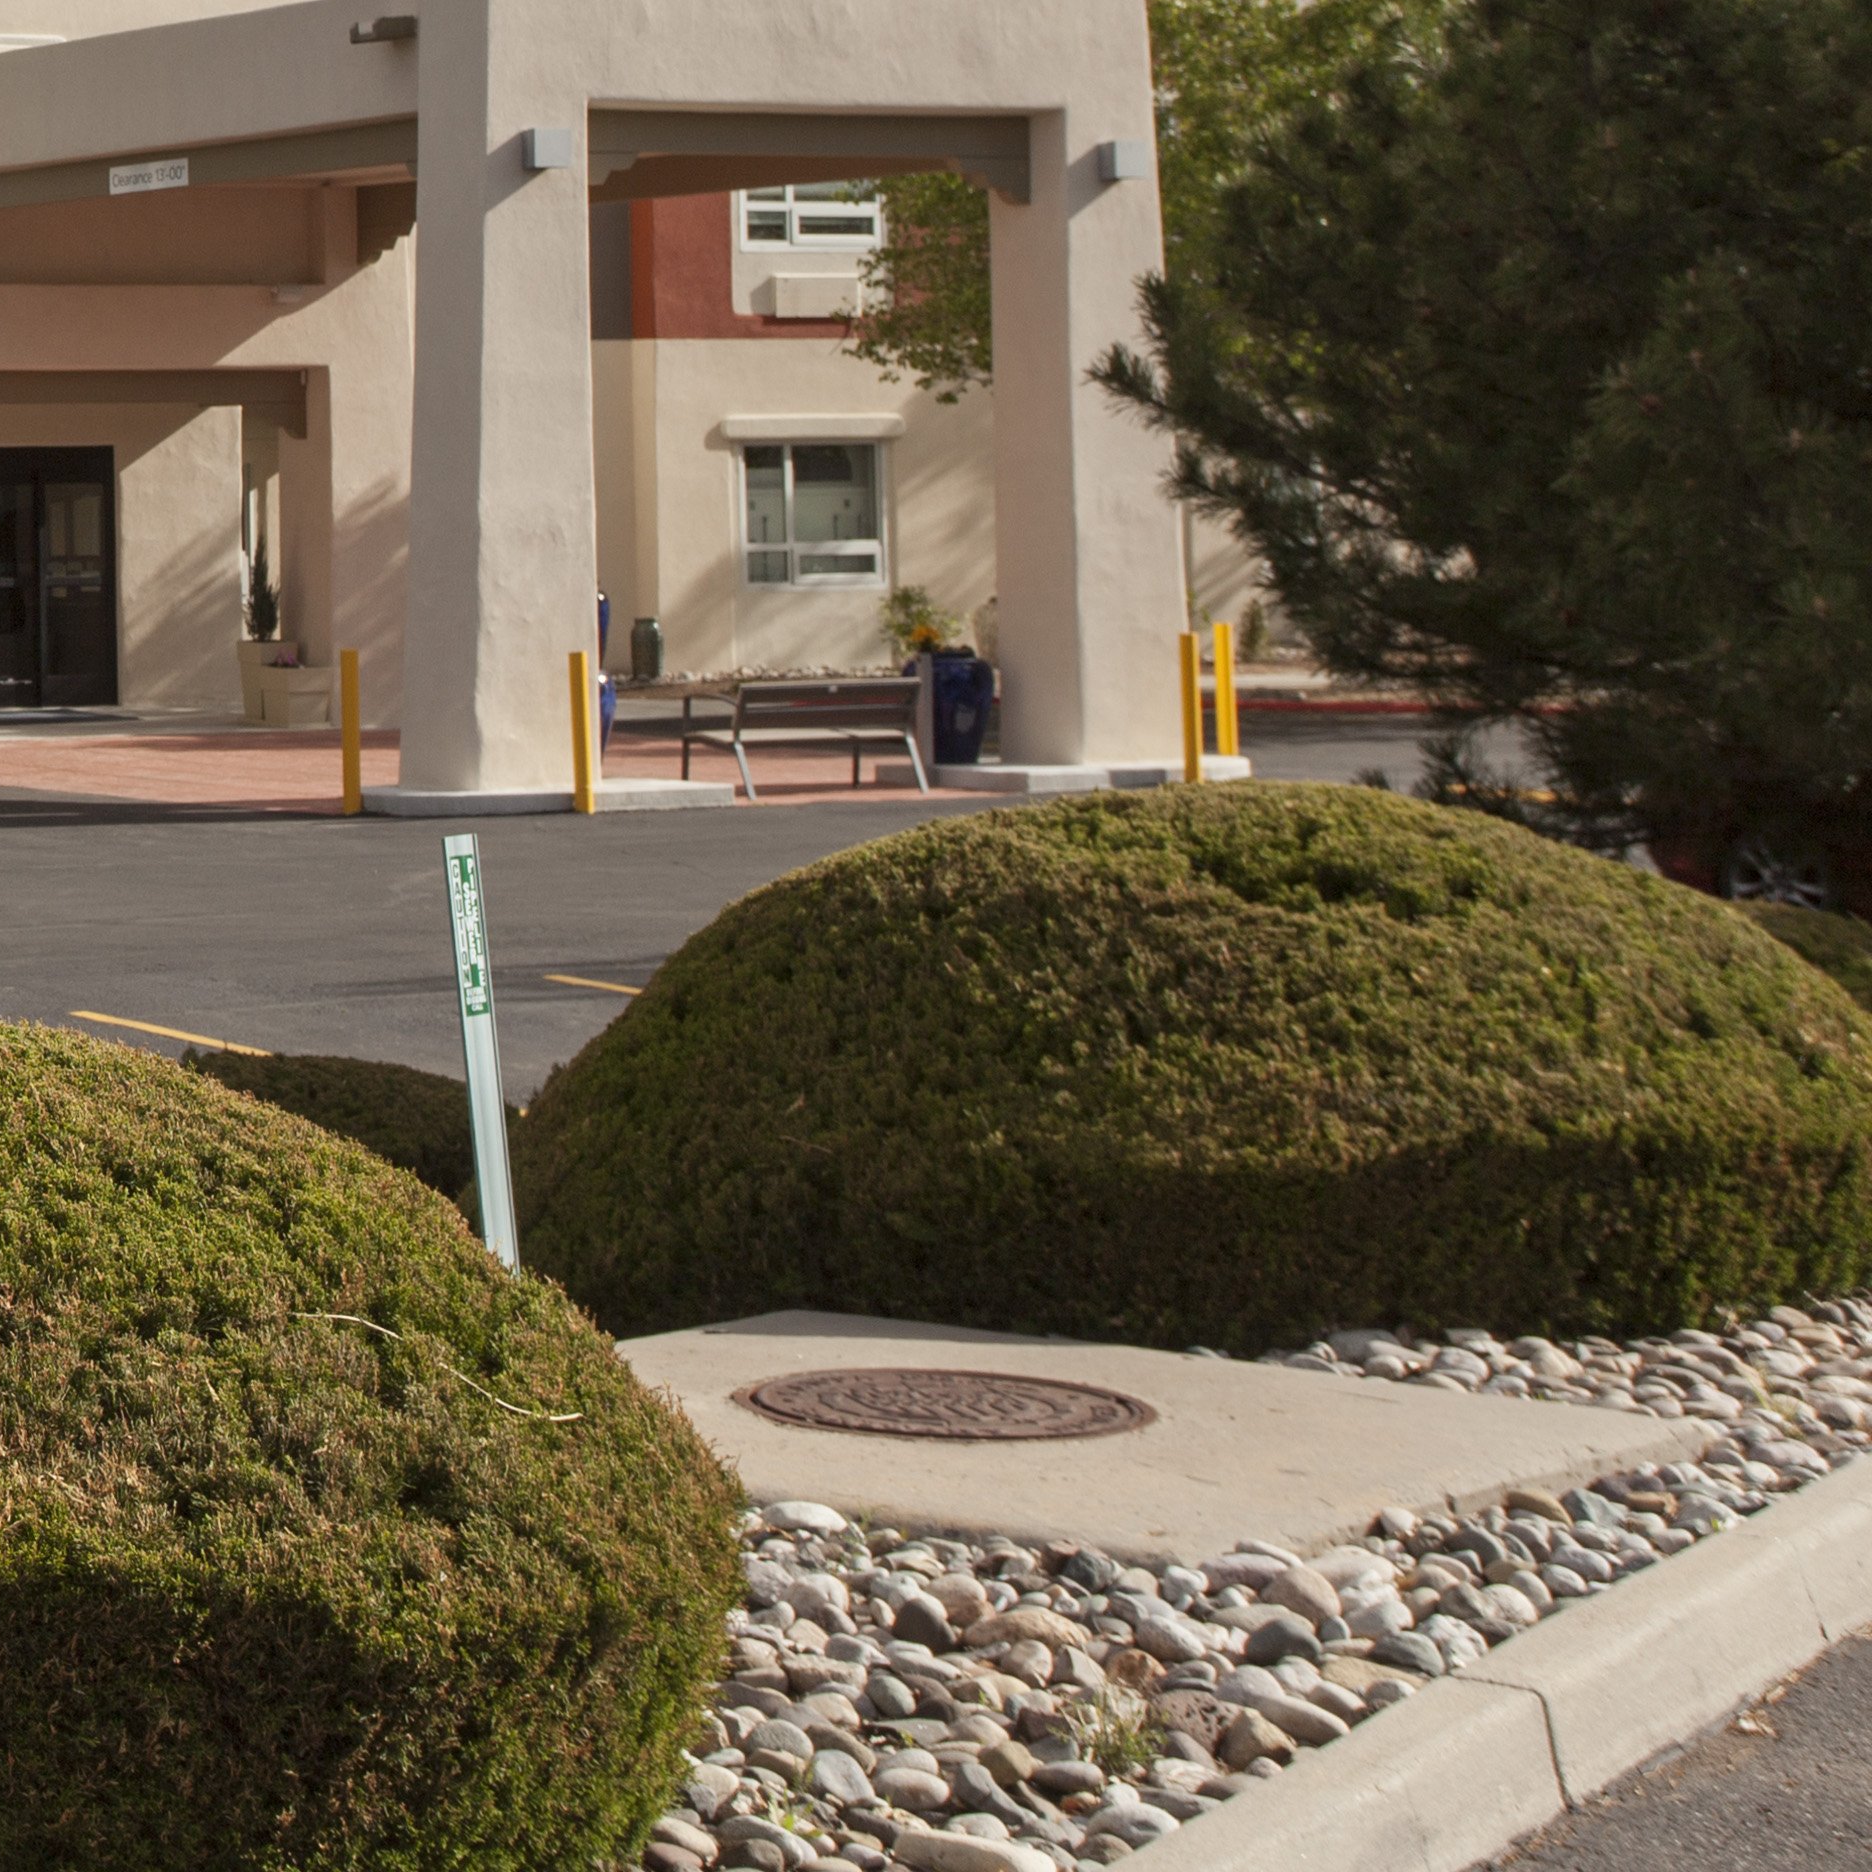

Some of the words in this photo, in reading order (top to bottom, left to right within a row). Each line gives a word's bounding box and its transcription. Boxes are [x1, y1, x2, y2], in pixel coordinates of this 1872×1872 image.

[112, 172, 153, 188] Clearance
[453, 864, 470, 983] CAUTION
[462, 882, 477, 965] SEWER
